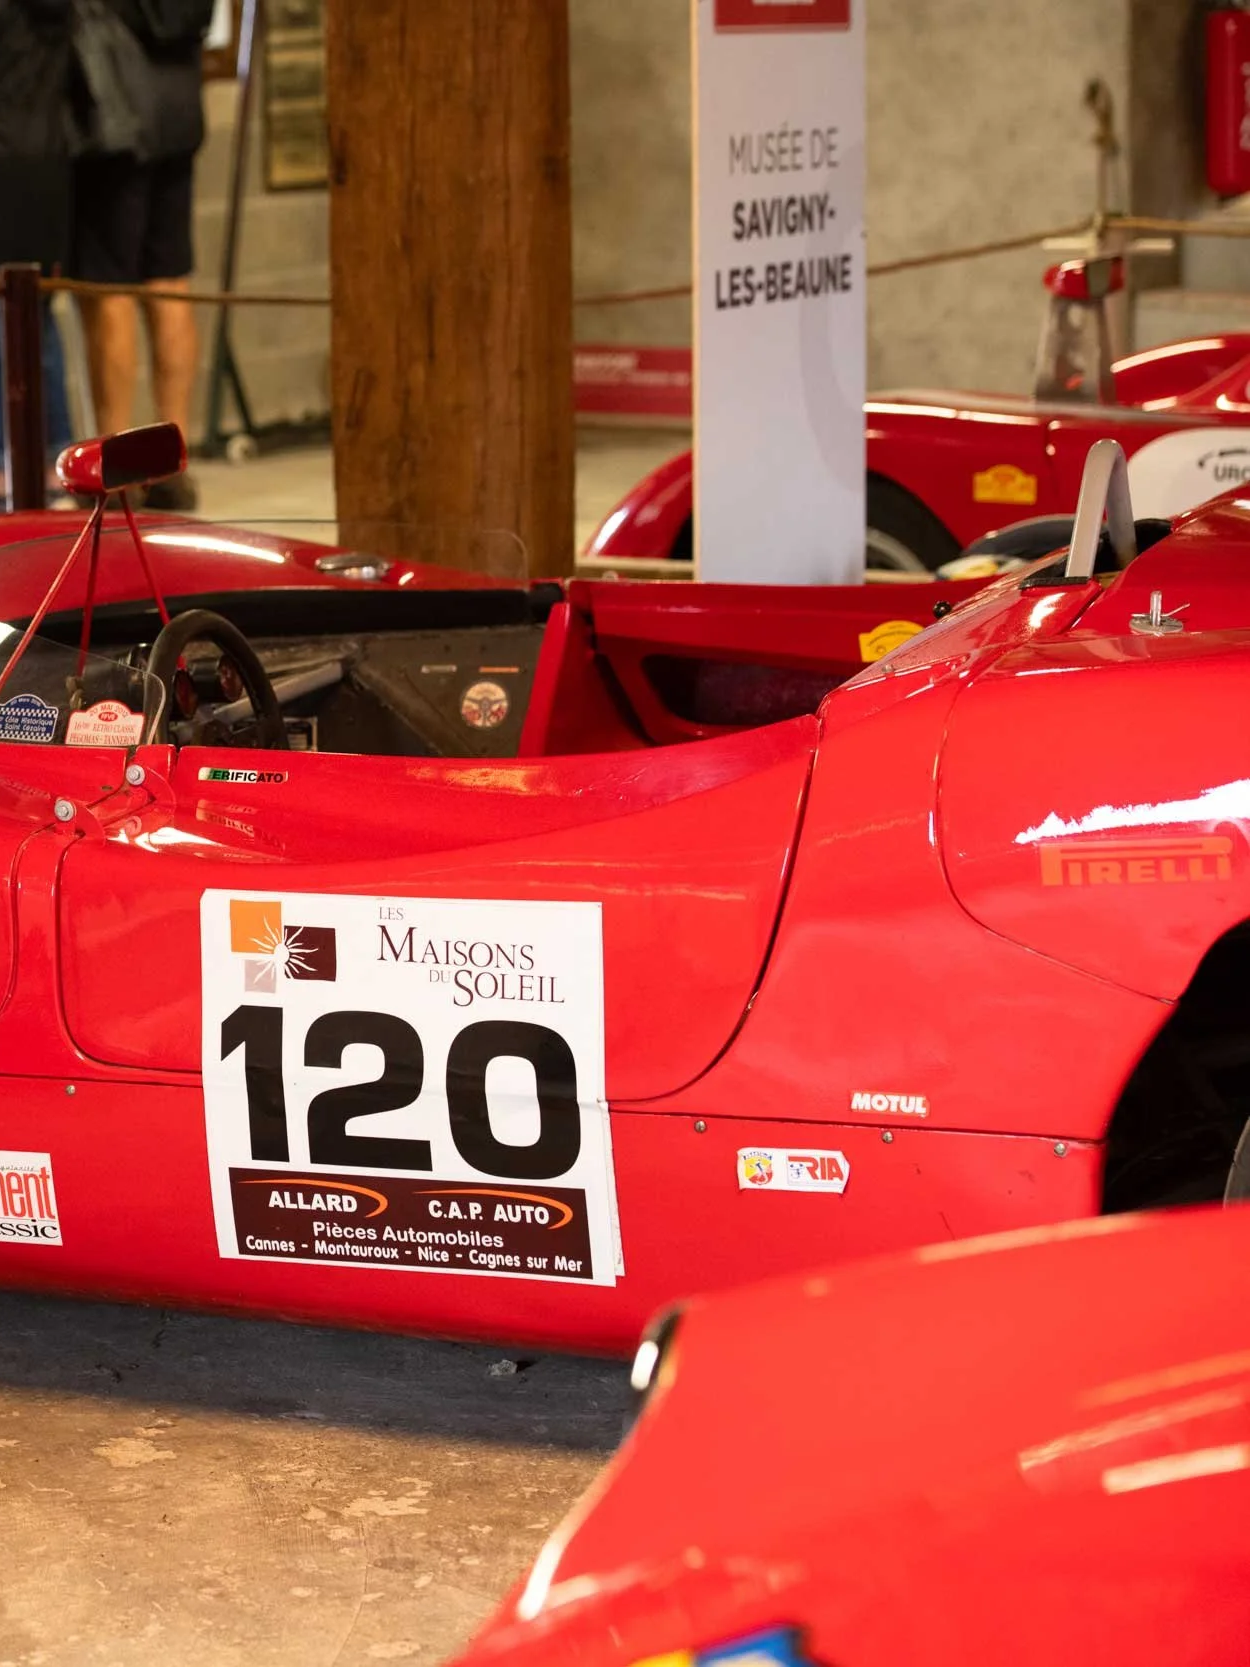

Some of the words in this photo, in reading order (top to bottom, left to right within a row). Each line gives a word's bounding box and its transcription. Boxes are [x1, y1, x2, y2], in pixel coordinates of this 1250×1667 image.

[729, 121, 803, 175] MUSÉE
[810, 126, 839, 169] DE
[733, 191, 836, 241] SAVIGNY-
[716, 254, 852, 310] LES-BEAUNE
[4, 723, 21, 731] Saint
[21, 716, 54, 727] Historique
[206, 770, 284, 783] ERIFICATO
[1040, 836, 1233, 887] PIRELLI
[379, 906, 405, 921] LES
[429, 969, 451, 984] DU
[220, 1004, 581, 1180] 120
[851, 1092, 927, 1114] MOTUL
[268, 1190, 358, 1213] ALLARD
[428, 1199, 483, 1221] C.A.P.
[493, 1203, 550, 1225] AUTO
[313, 1221, 377, 1241] Pièces
[382, 1225, 504, 1248] Automobiles
[246, 1235, 296, 1253] Cannes
[314, 1240, 399, 1260] Montauroux
[418, 1247, 449, 1263] Nice
[469, 1249, 521, 1269] Cagnes
[527, 1257, 548, 1270] sur
[554, 1255, 583, 1272] Mer
